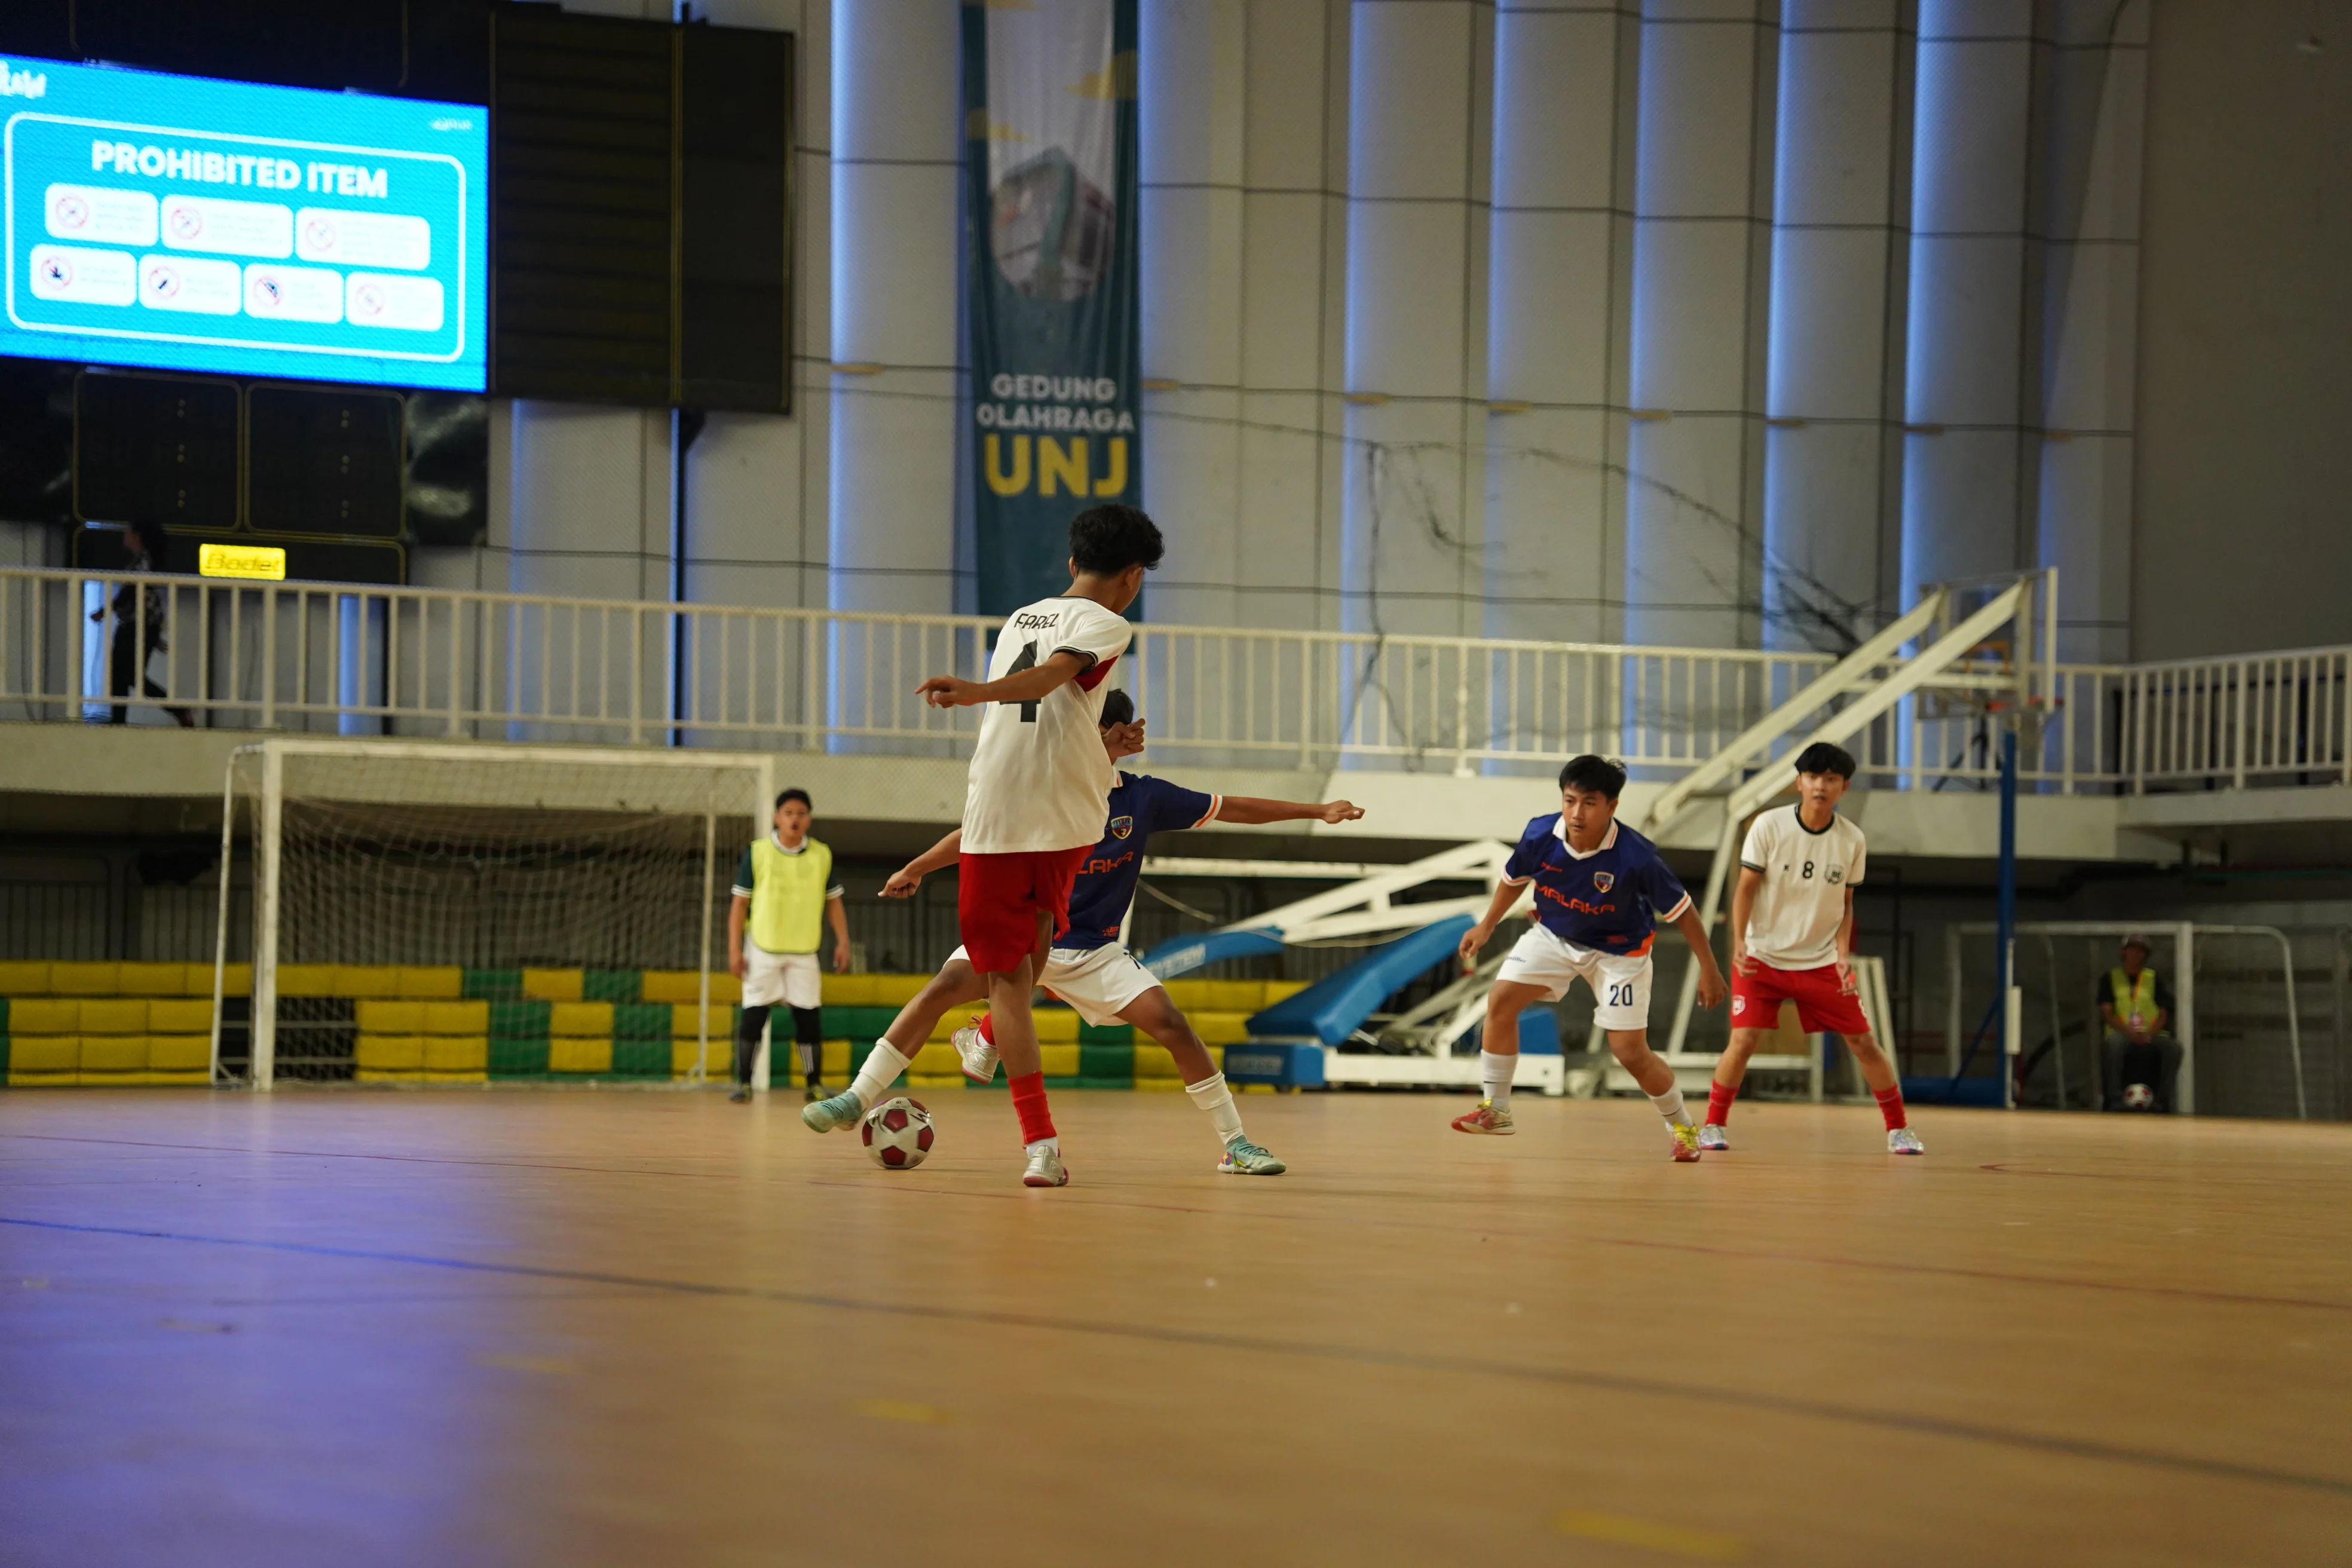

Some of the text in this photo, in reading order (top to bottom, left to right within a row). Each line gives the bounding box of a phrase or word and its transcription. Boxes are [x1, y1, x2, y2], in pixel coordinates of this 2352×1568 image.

[91, 139, 388, 199] PROHIBITED ITEM
[990, 373, 1117, 403] GEDUNG
[976, 403, 1135, 432] OLAHRAGA
[985, 433, 1128, 498] UNJ
[1014, 612, 1060, 630] FAREL
[999, 638, 1042, 723] 4
[1802, 860, 1814, 879] 8
[1535, 881, 1615, 915] MALAKA
[1609, 984, 1633, 1006] 20
